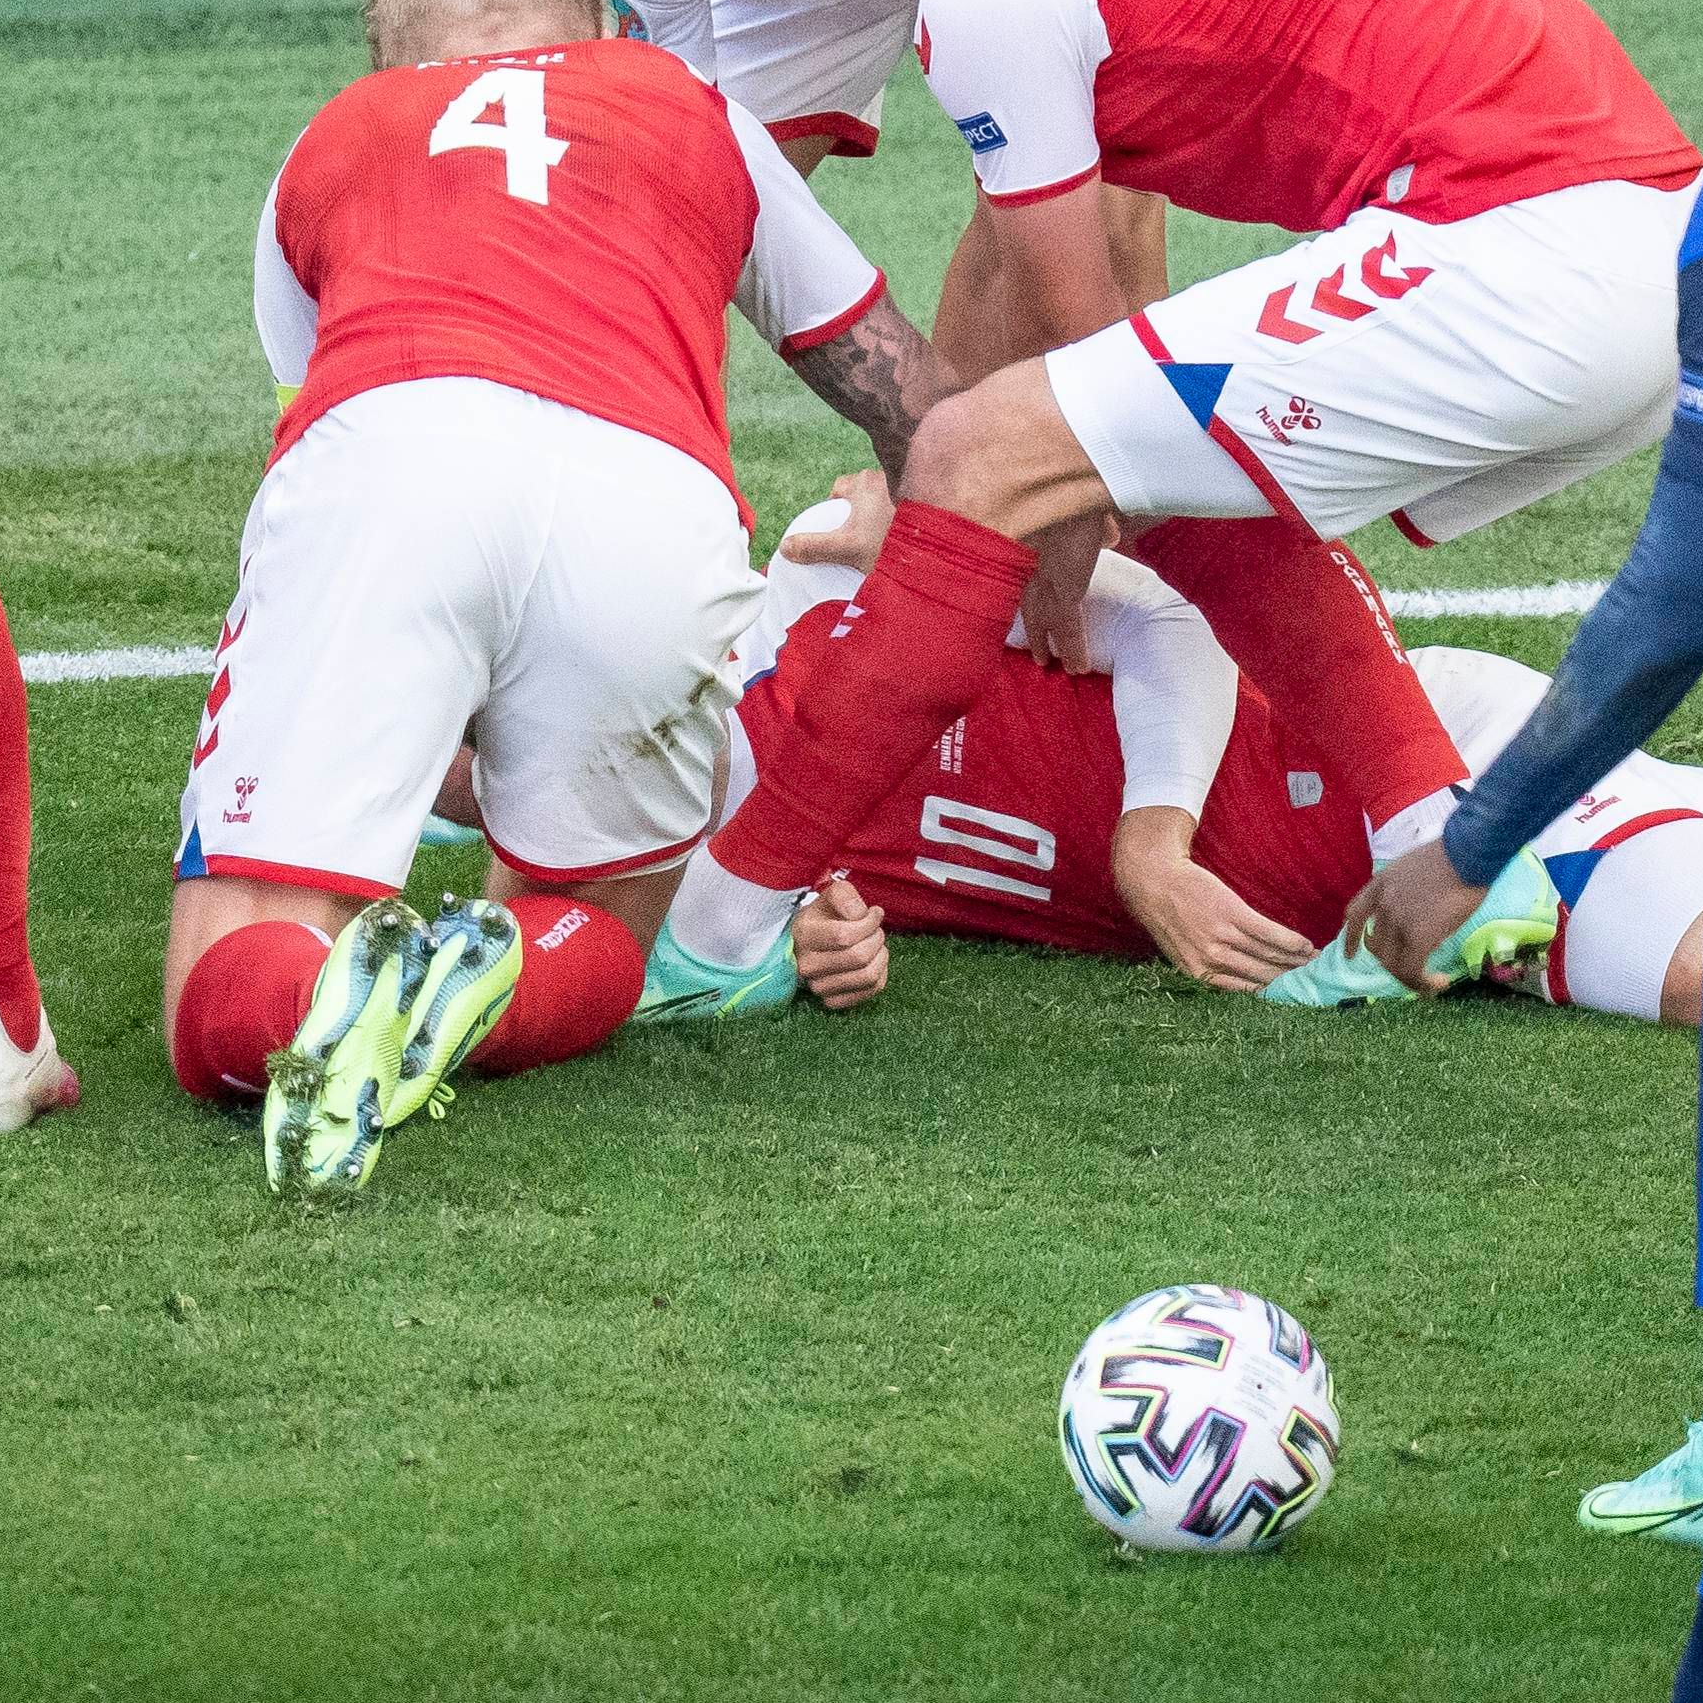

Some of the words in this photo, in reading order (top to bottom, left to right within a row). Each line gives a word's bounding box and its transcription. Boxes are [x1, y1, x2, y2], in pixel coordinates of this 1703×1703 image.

[427, 67, 571, 207] 4
[964, 121, 999, 145] PECT
[914, 795, 1056, 901] 10
